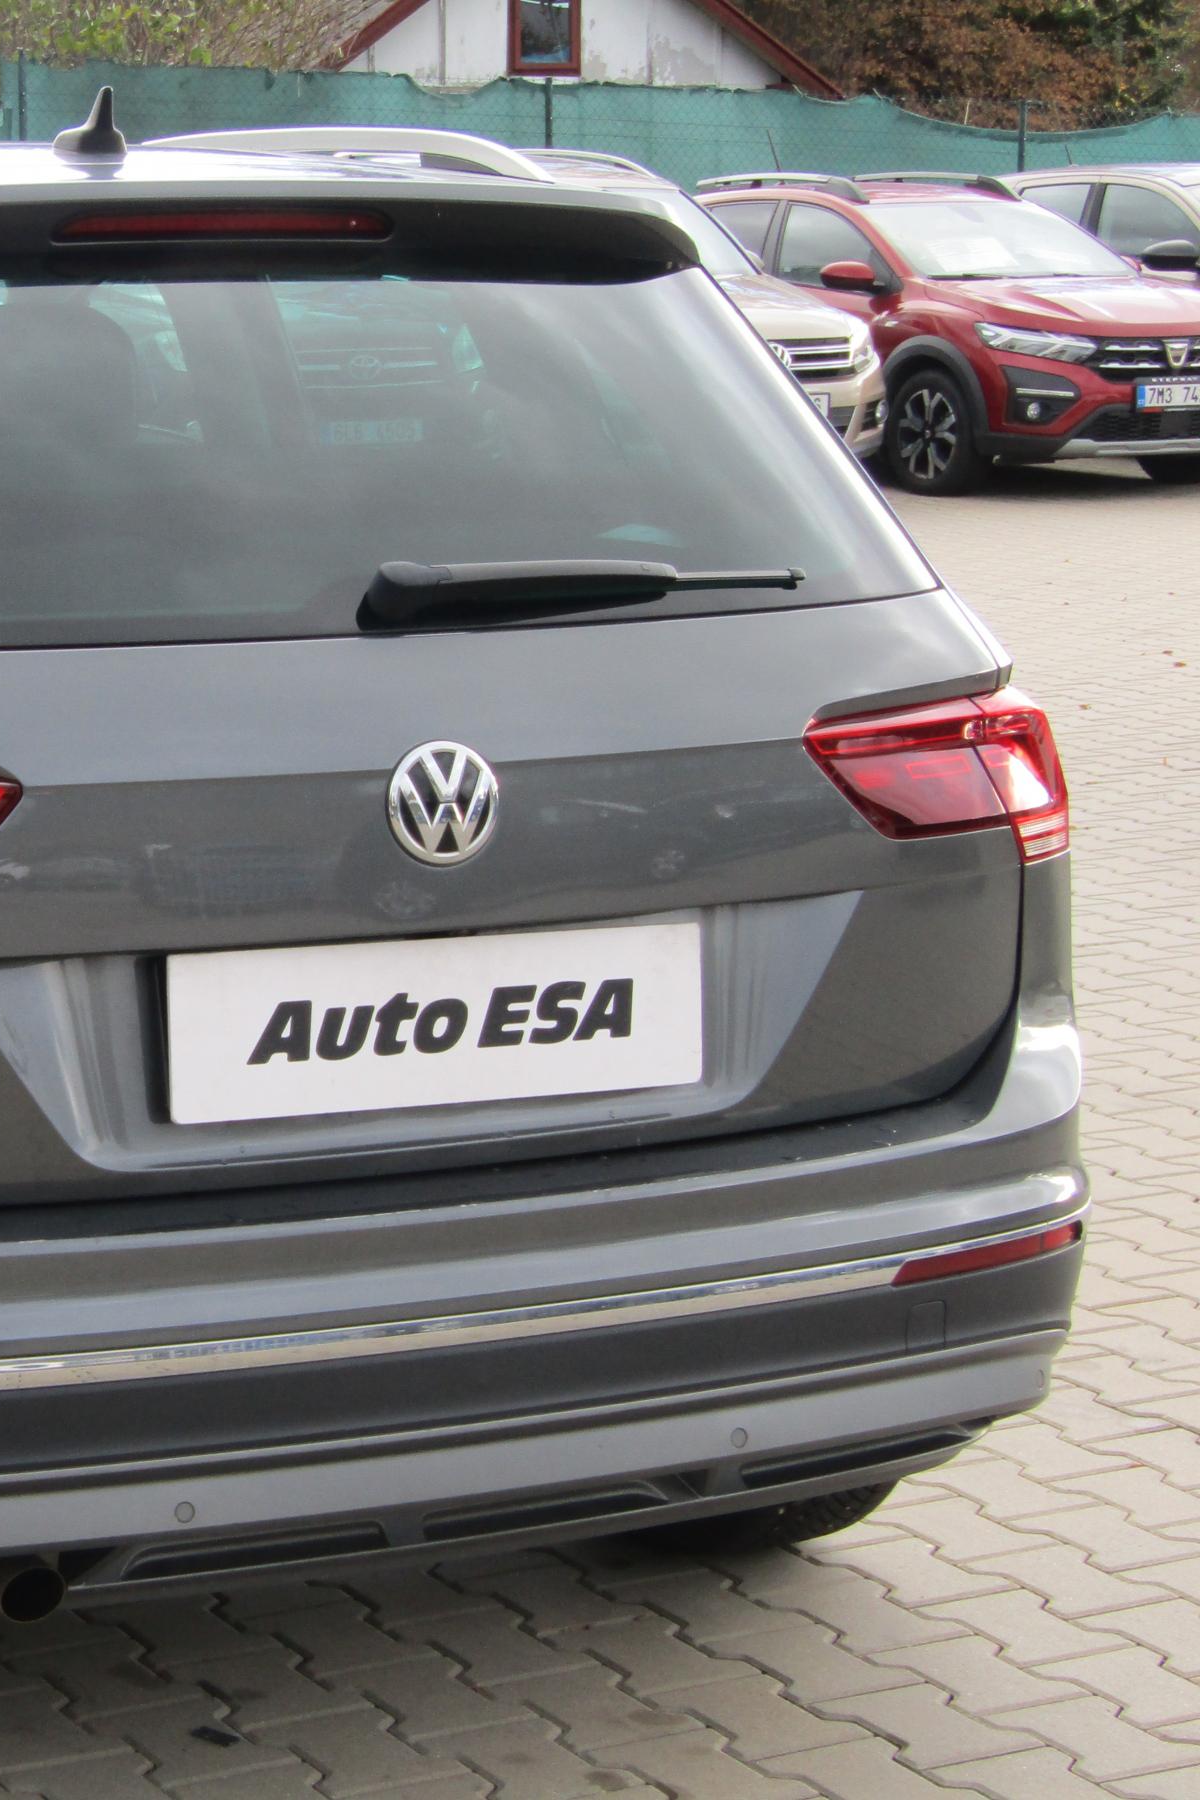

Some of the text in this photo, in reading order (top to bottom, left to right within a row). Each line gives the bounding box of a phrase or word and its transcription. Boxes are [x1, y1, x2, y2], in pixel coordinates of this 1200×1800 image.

[1148, 387, 1173, 404] 7M3
[1183, 386, 1200, 403] 74
[386, 740, 499, 866] VW
[246, 978, 634, 1065] Auto ESA
